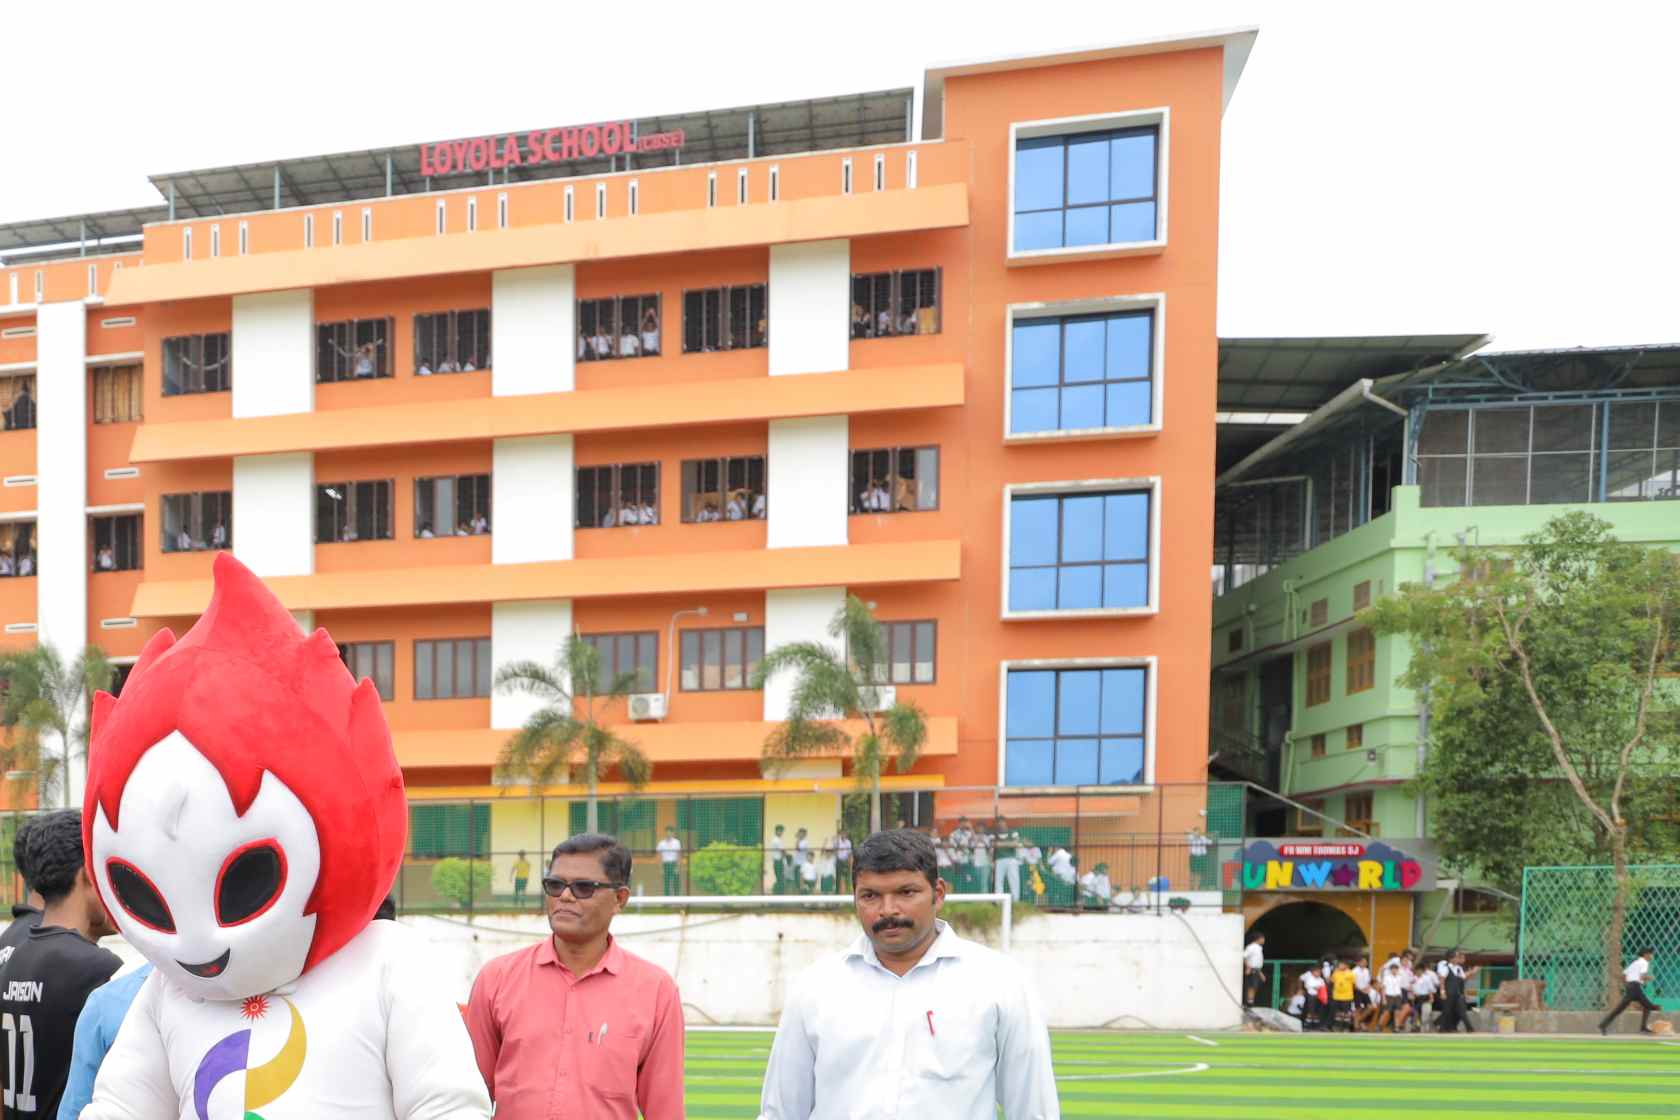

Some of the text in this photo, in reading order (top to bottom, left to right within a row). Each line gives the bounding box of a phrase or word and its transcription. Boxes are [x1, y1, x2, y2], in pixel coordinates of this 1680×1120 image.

[420, 133, 521, 177] LOYOLA
[527, 119, 637, 165] SCHOOL
[1297, 860, 1424, 890] WRLD
[2, 980, 44, 1003] JAISON
[2, 1013, 37, 1112] 11
